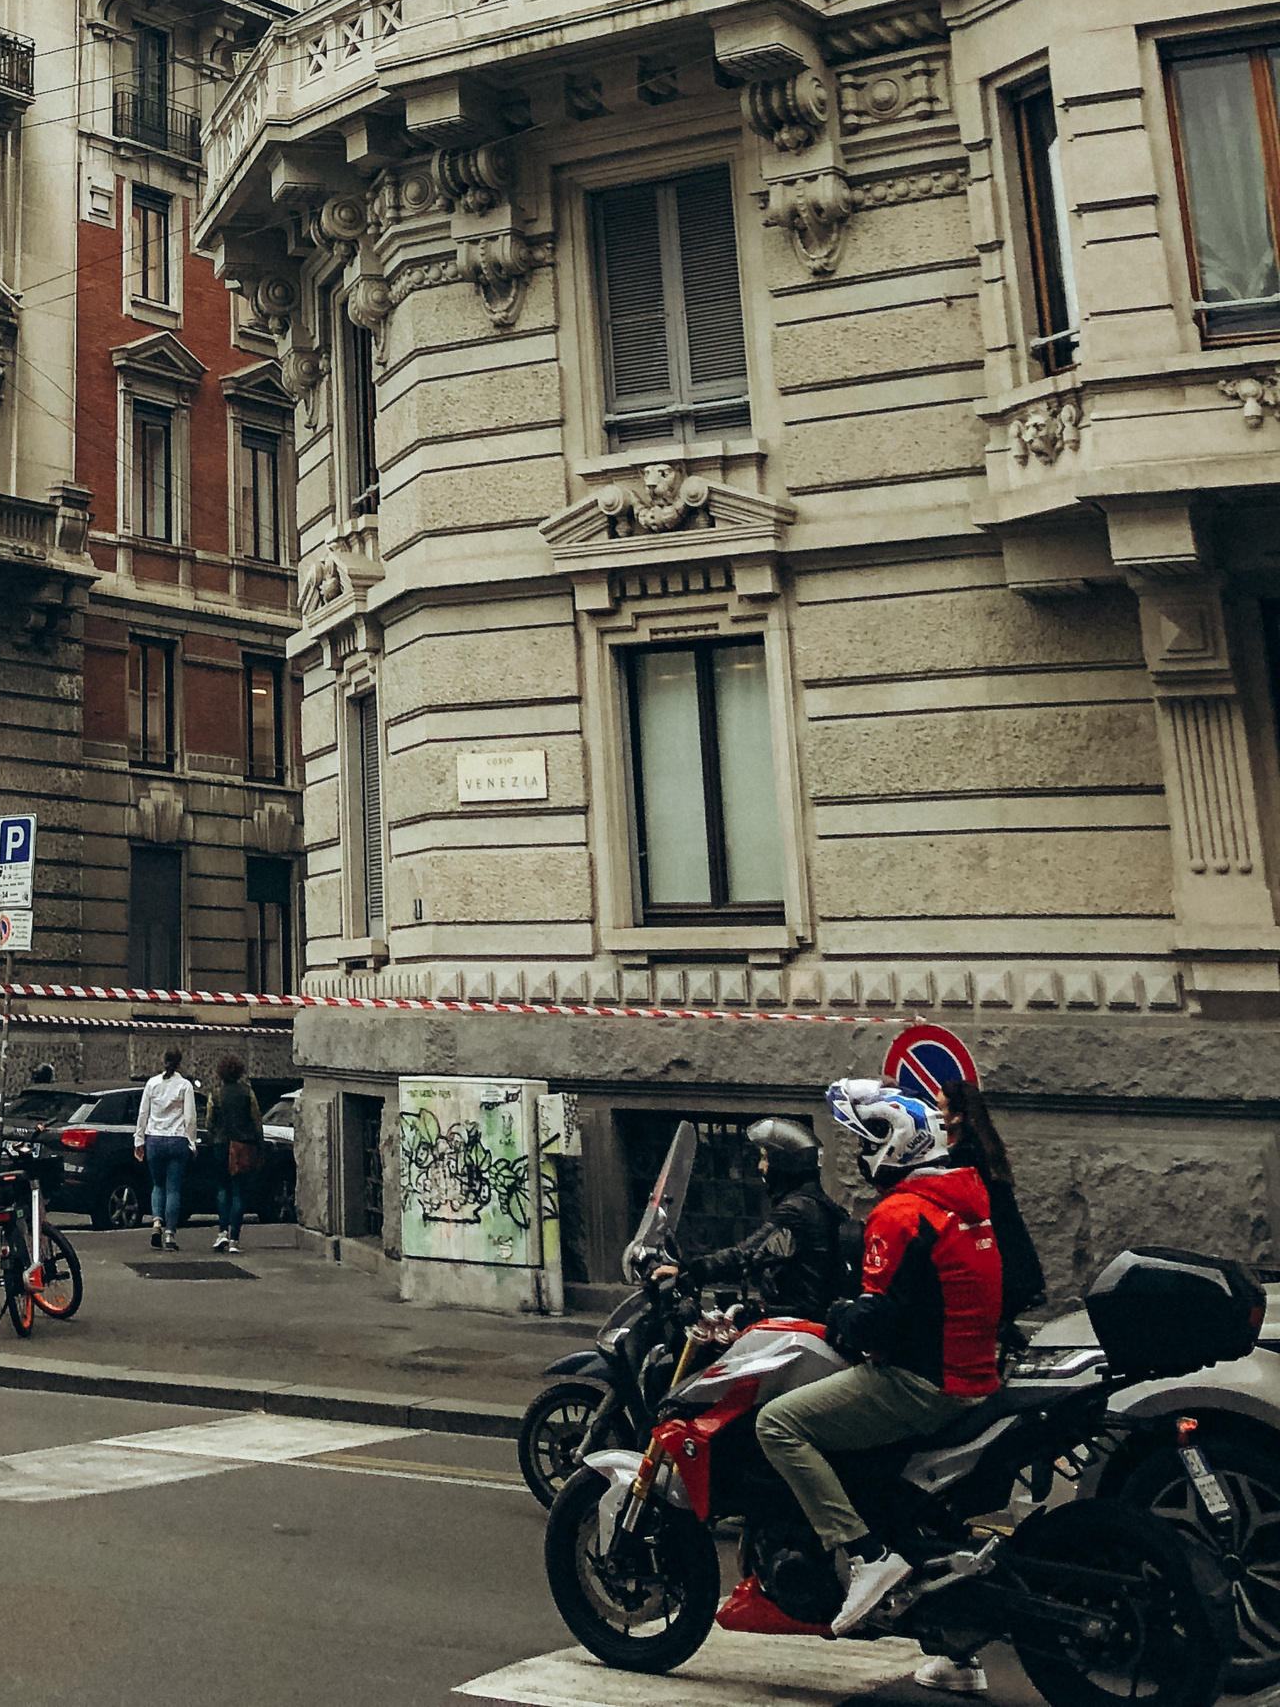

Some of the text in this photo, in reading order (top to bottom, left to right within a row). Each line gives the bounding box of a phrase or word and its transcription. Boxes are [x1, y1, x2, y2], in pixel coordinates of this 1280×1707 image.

[486, 757, 514, 766] CORSO
[465, 776, 538, 790] VENEZIA
[5, 825, 25, 861] P
[906, 1131, 927, 1149] SHOEI
